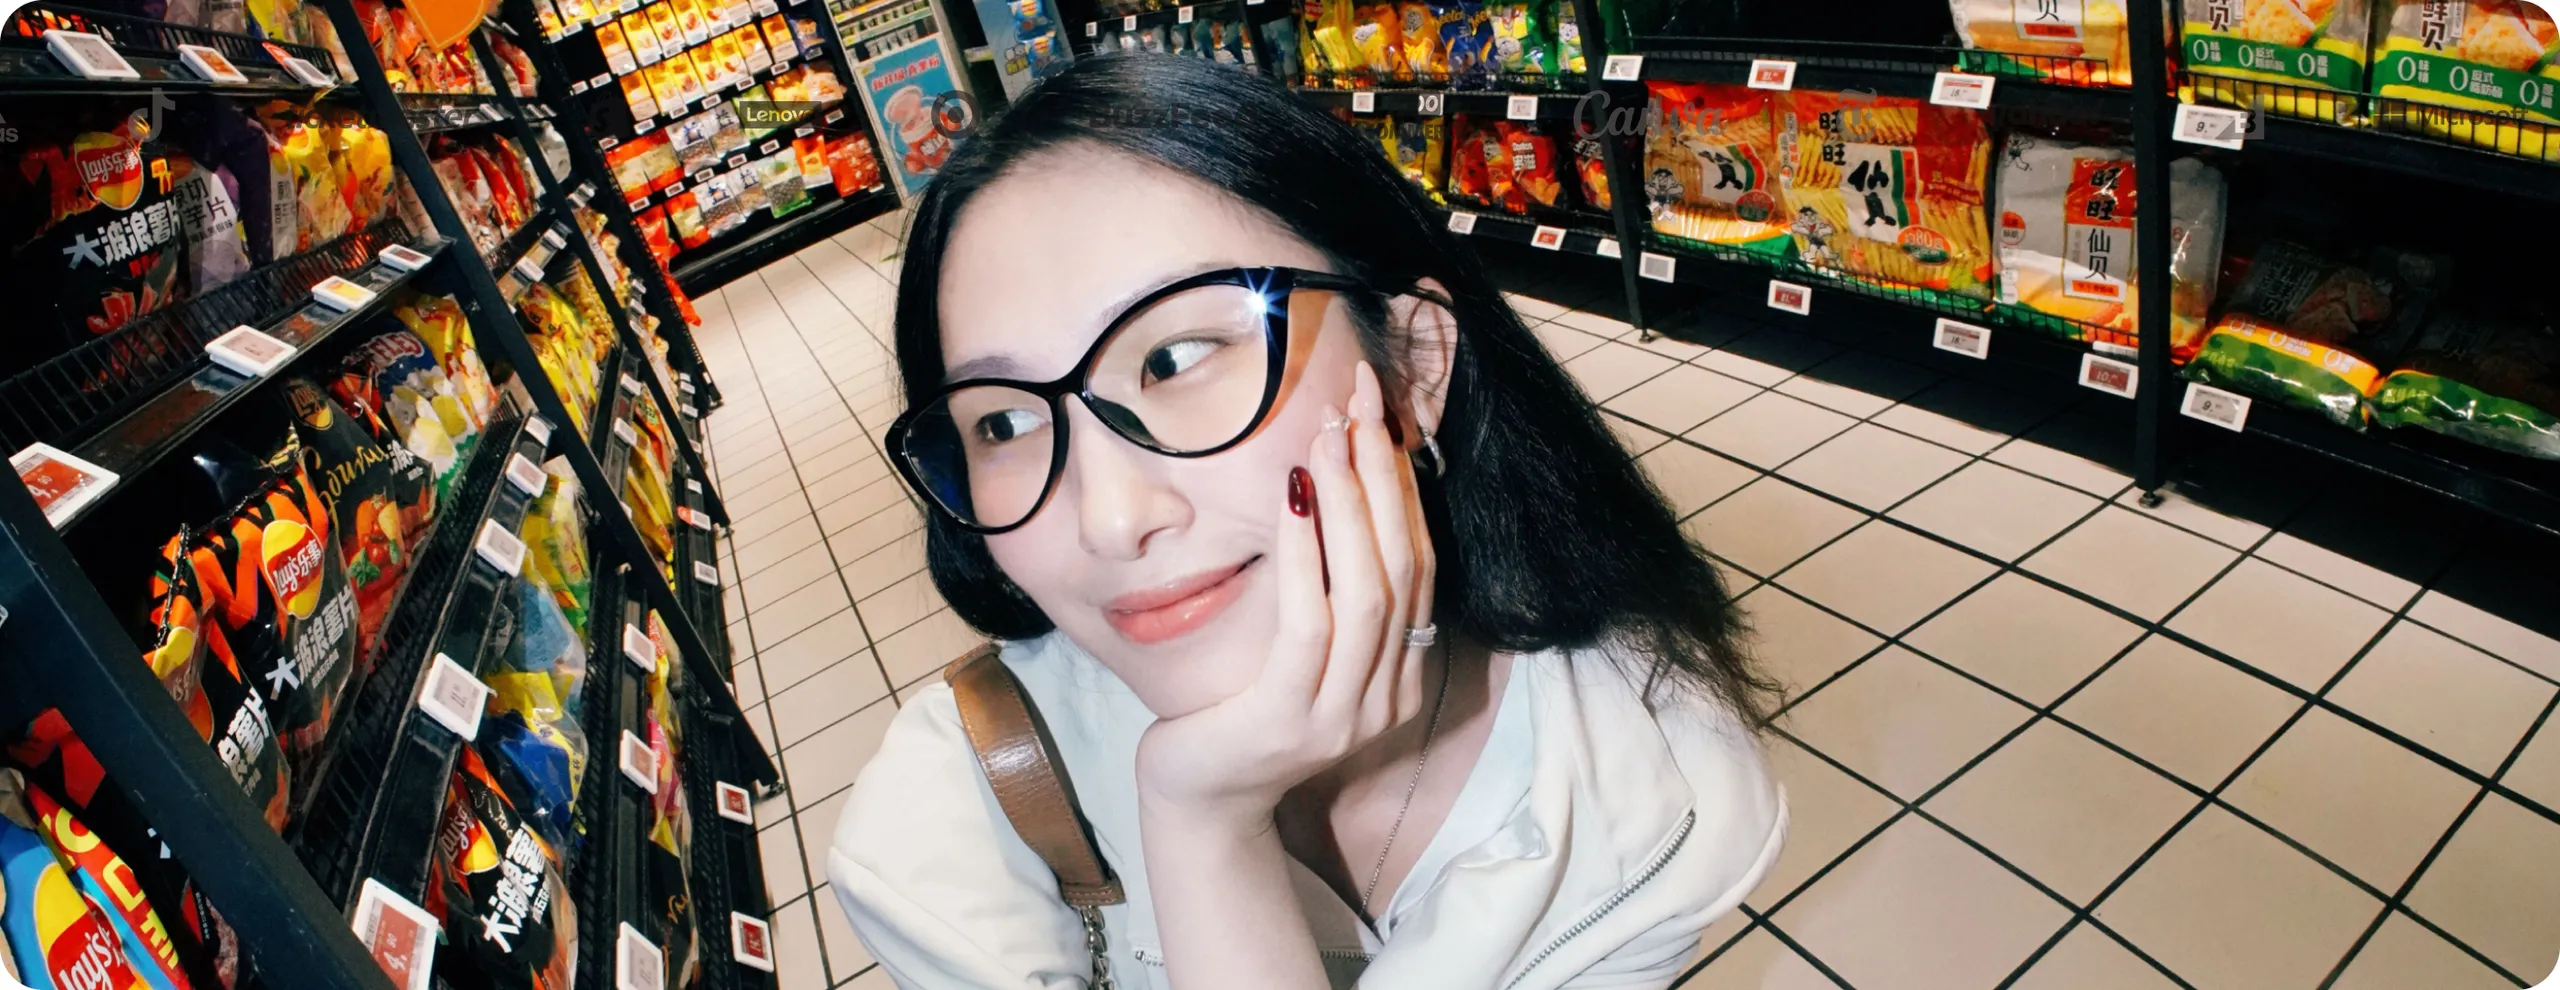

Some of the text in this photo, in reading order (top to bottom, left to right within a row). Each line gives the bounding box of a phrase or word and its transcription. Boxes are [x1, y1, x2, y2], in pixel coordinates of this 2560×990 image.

[82, 153, 114, 183] Lay's
[2087, 227, 2111, 280] 仙贝
[273, 556, 300, 598] Lay's
[296, 539, 322, 577] 乐事
[265, 585, 356, 701] 大波浪薯片
